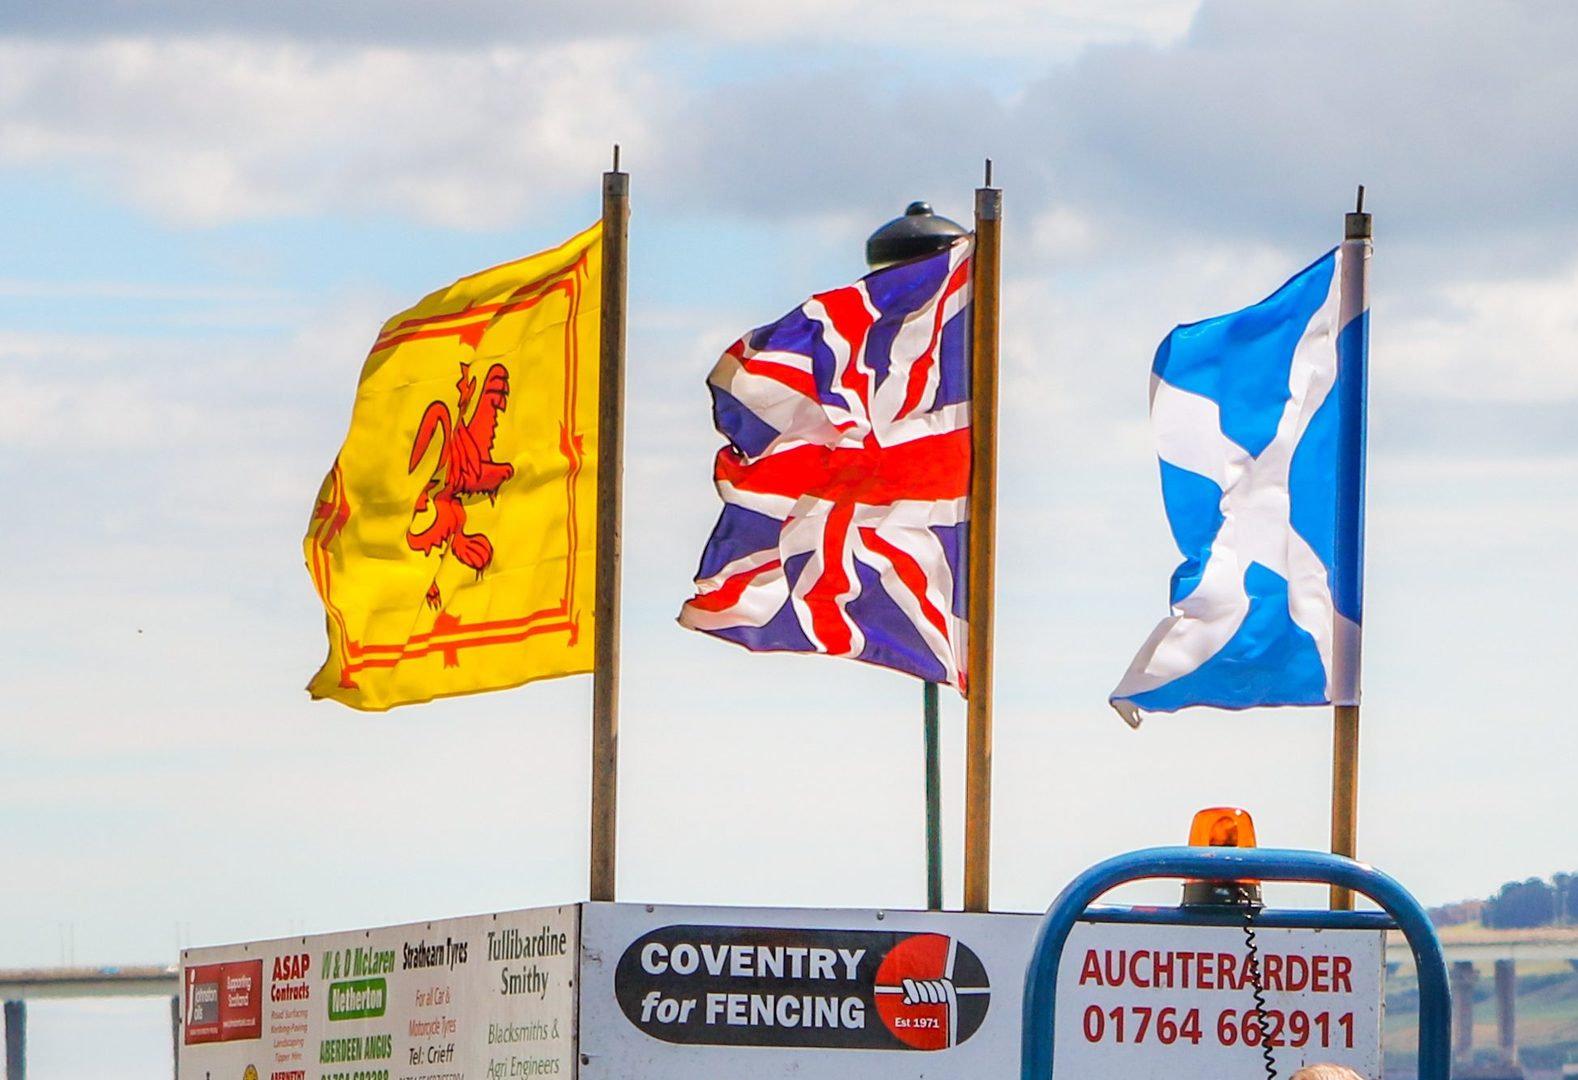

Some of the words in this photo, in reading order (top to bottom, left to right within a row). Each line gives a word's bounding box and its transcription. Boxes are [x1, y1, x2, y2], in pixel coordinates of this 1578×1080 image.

[403, 941, 444, 971] Strathearn
[446, 937, 468, 972] Tyres
[487, 926, 567, 961] Tullibardine
[272, 953, 310, 982] ASAP
[322, 952, 332, 980] W
[344, 951, 351, 978] D
[353, 945, 396, 977] McLaren
[640, 942, 866, 981] COVENTRY
[1078, 949, 1354, 994] AUCHTERARDER
[270, 981, 310, 1003] Contracts
[500, 967, 550, 1000] Smithy
[332, 987, 382, 1014] Netherton
[640, 991, 697, 1024] for
[705, 993, 866, 1030] FENCING
[488, 1022, 548, 1044] Blacksmiths
[551, 1018, 560, 1040] &
[894, 1016, 912, 1028] Est
[913, 1016, 940, 1029] 1971
[1082, 1004, 1203, 1044] 01764
[1216, 1008, 1354, 1048] 662911
[320, 1037, 363, 1064] ABERDEEN
[364, 1034, 392, 1060] ANGUS
[408, 1047, 424, 1066] Tel:
[427, 1043, 455, 1064] Crieff
